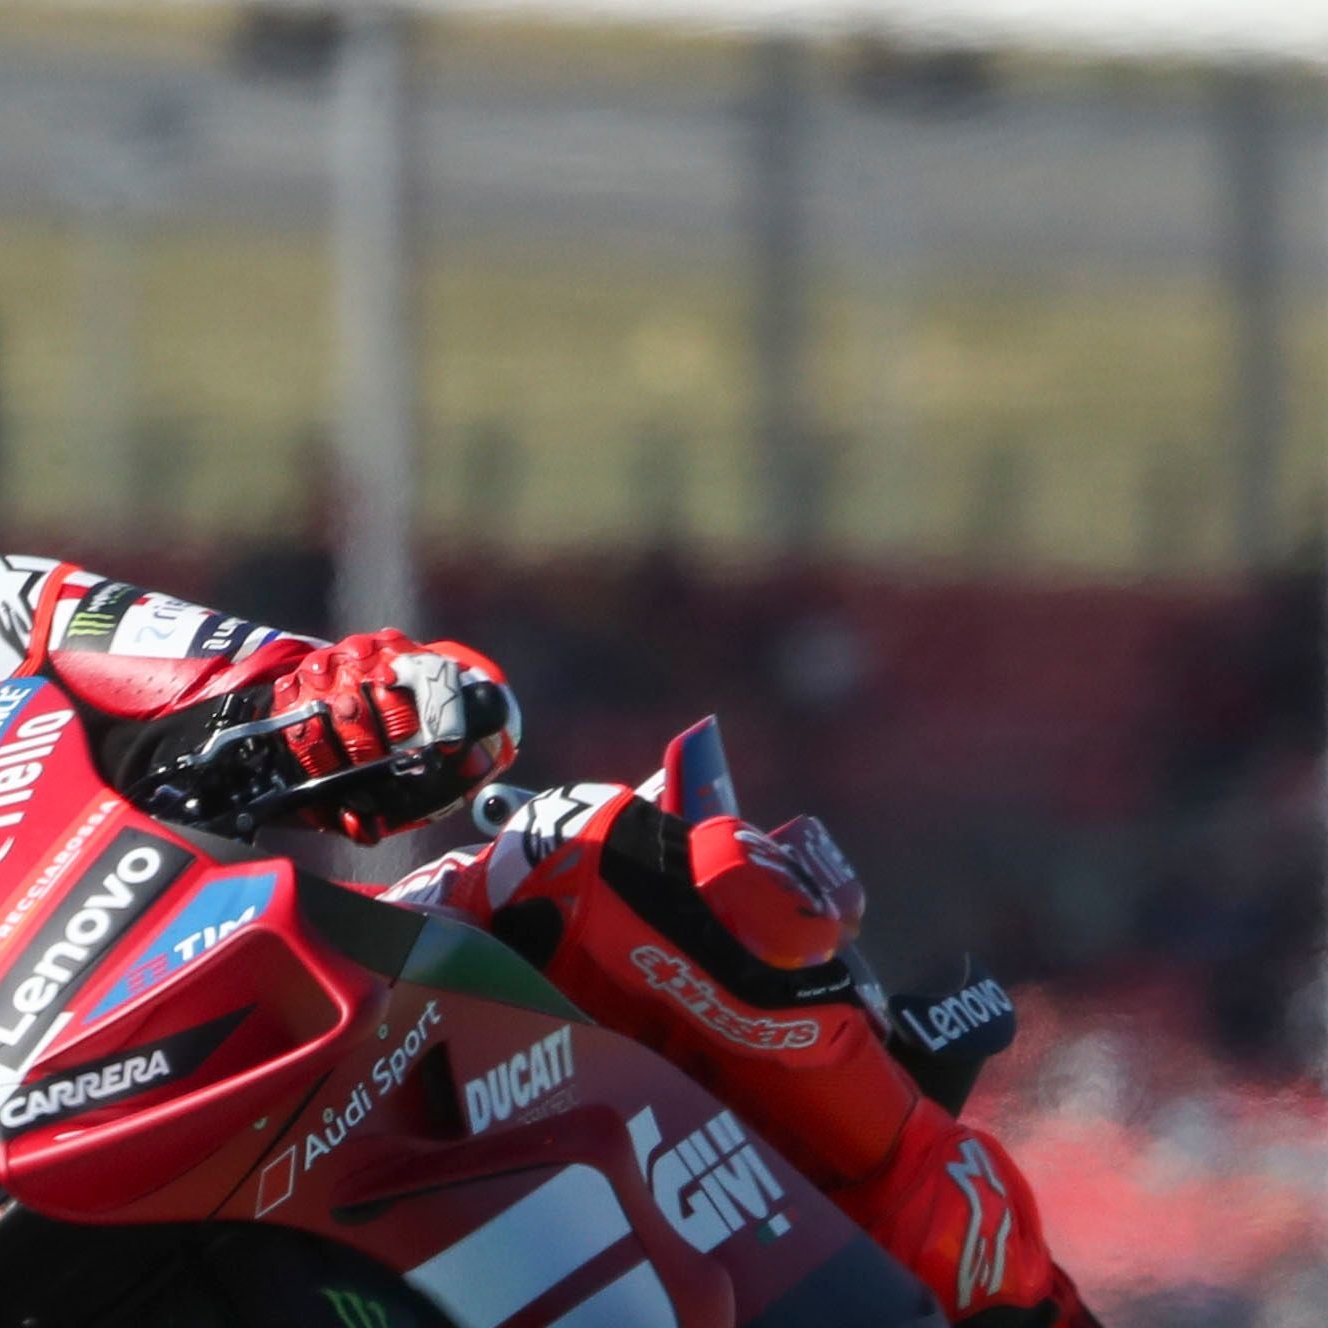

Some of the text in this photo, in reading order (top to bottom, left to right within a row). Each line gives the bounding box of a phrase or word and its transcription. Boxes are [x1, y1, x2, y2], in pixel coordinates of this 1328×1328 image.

[174, 906, 256, 961] TIM
[901, 978, 1013, 1052] Lenovo
[0, 1049, 170, 1129] CARRERA
[303, 1000, 442, 1171] Audi Sport
[465, 1023, 574, 1136] DUCATI
